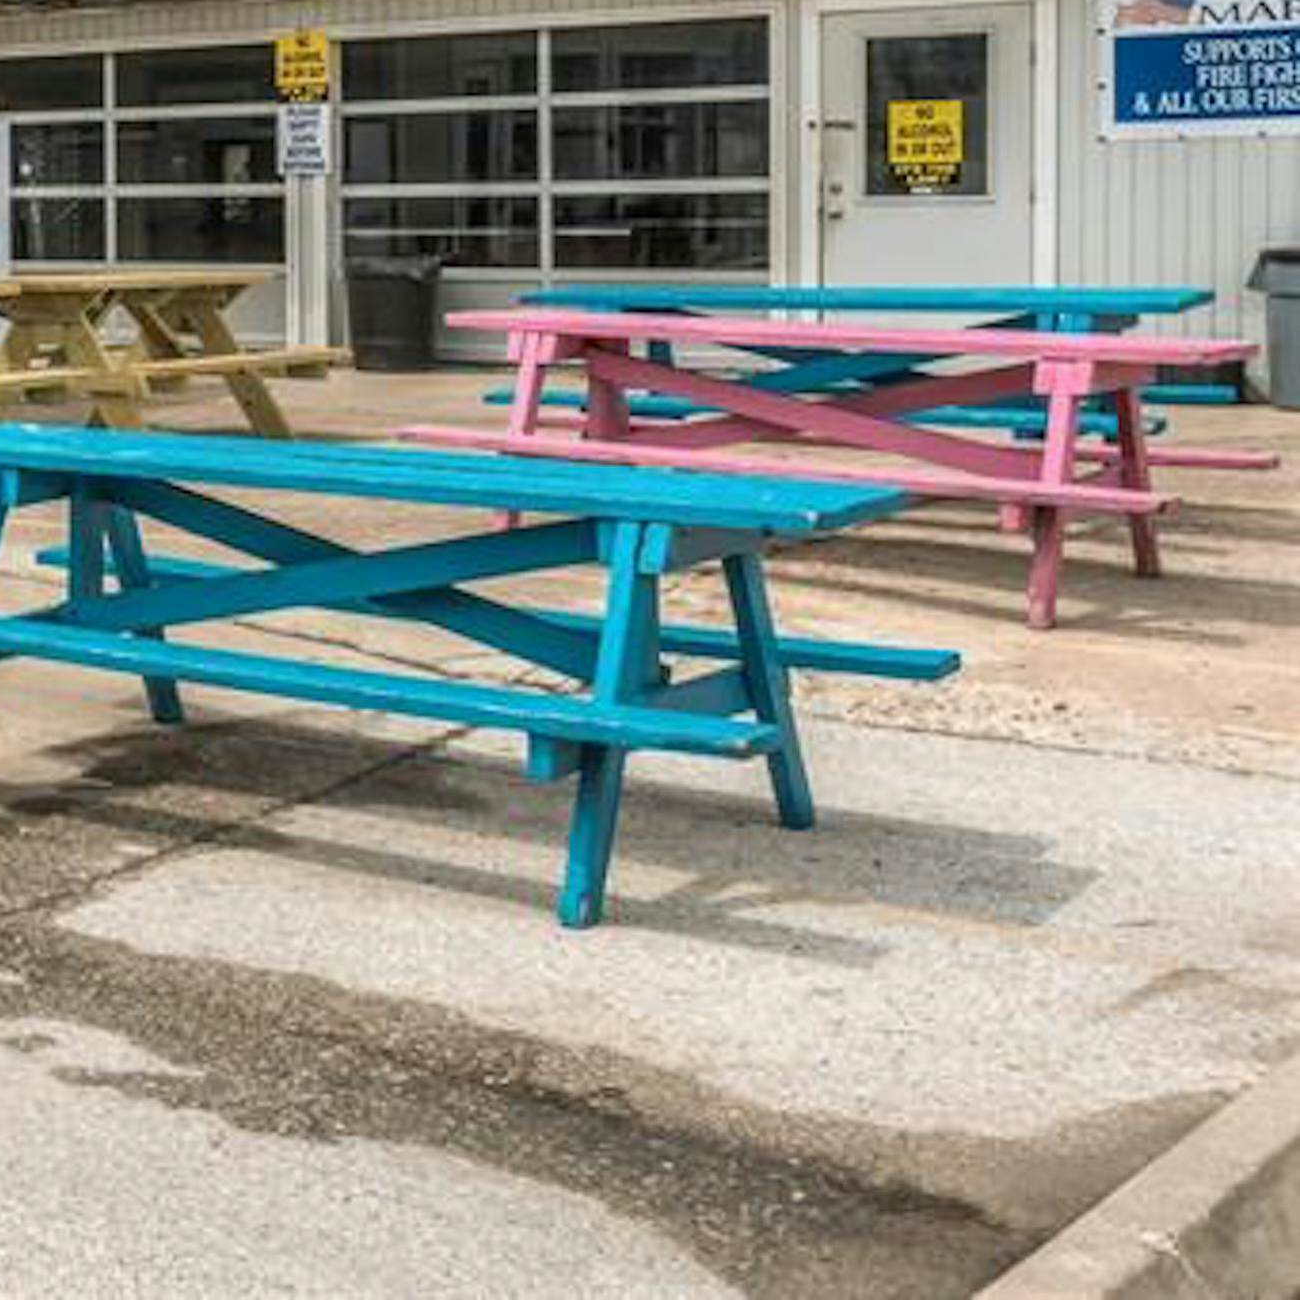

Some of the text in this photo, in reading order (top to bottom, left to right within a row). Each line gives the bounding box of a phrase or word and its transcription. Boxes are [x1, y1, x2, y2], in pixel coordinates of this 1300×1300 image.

[1181, 36, 1293, 65] SUPPORTS
[1196, 63, 1248, 88] FIRE
[1157, 91, 1199, 115] ALL
[1203, 88, 1250, 113] OUR
